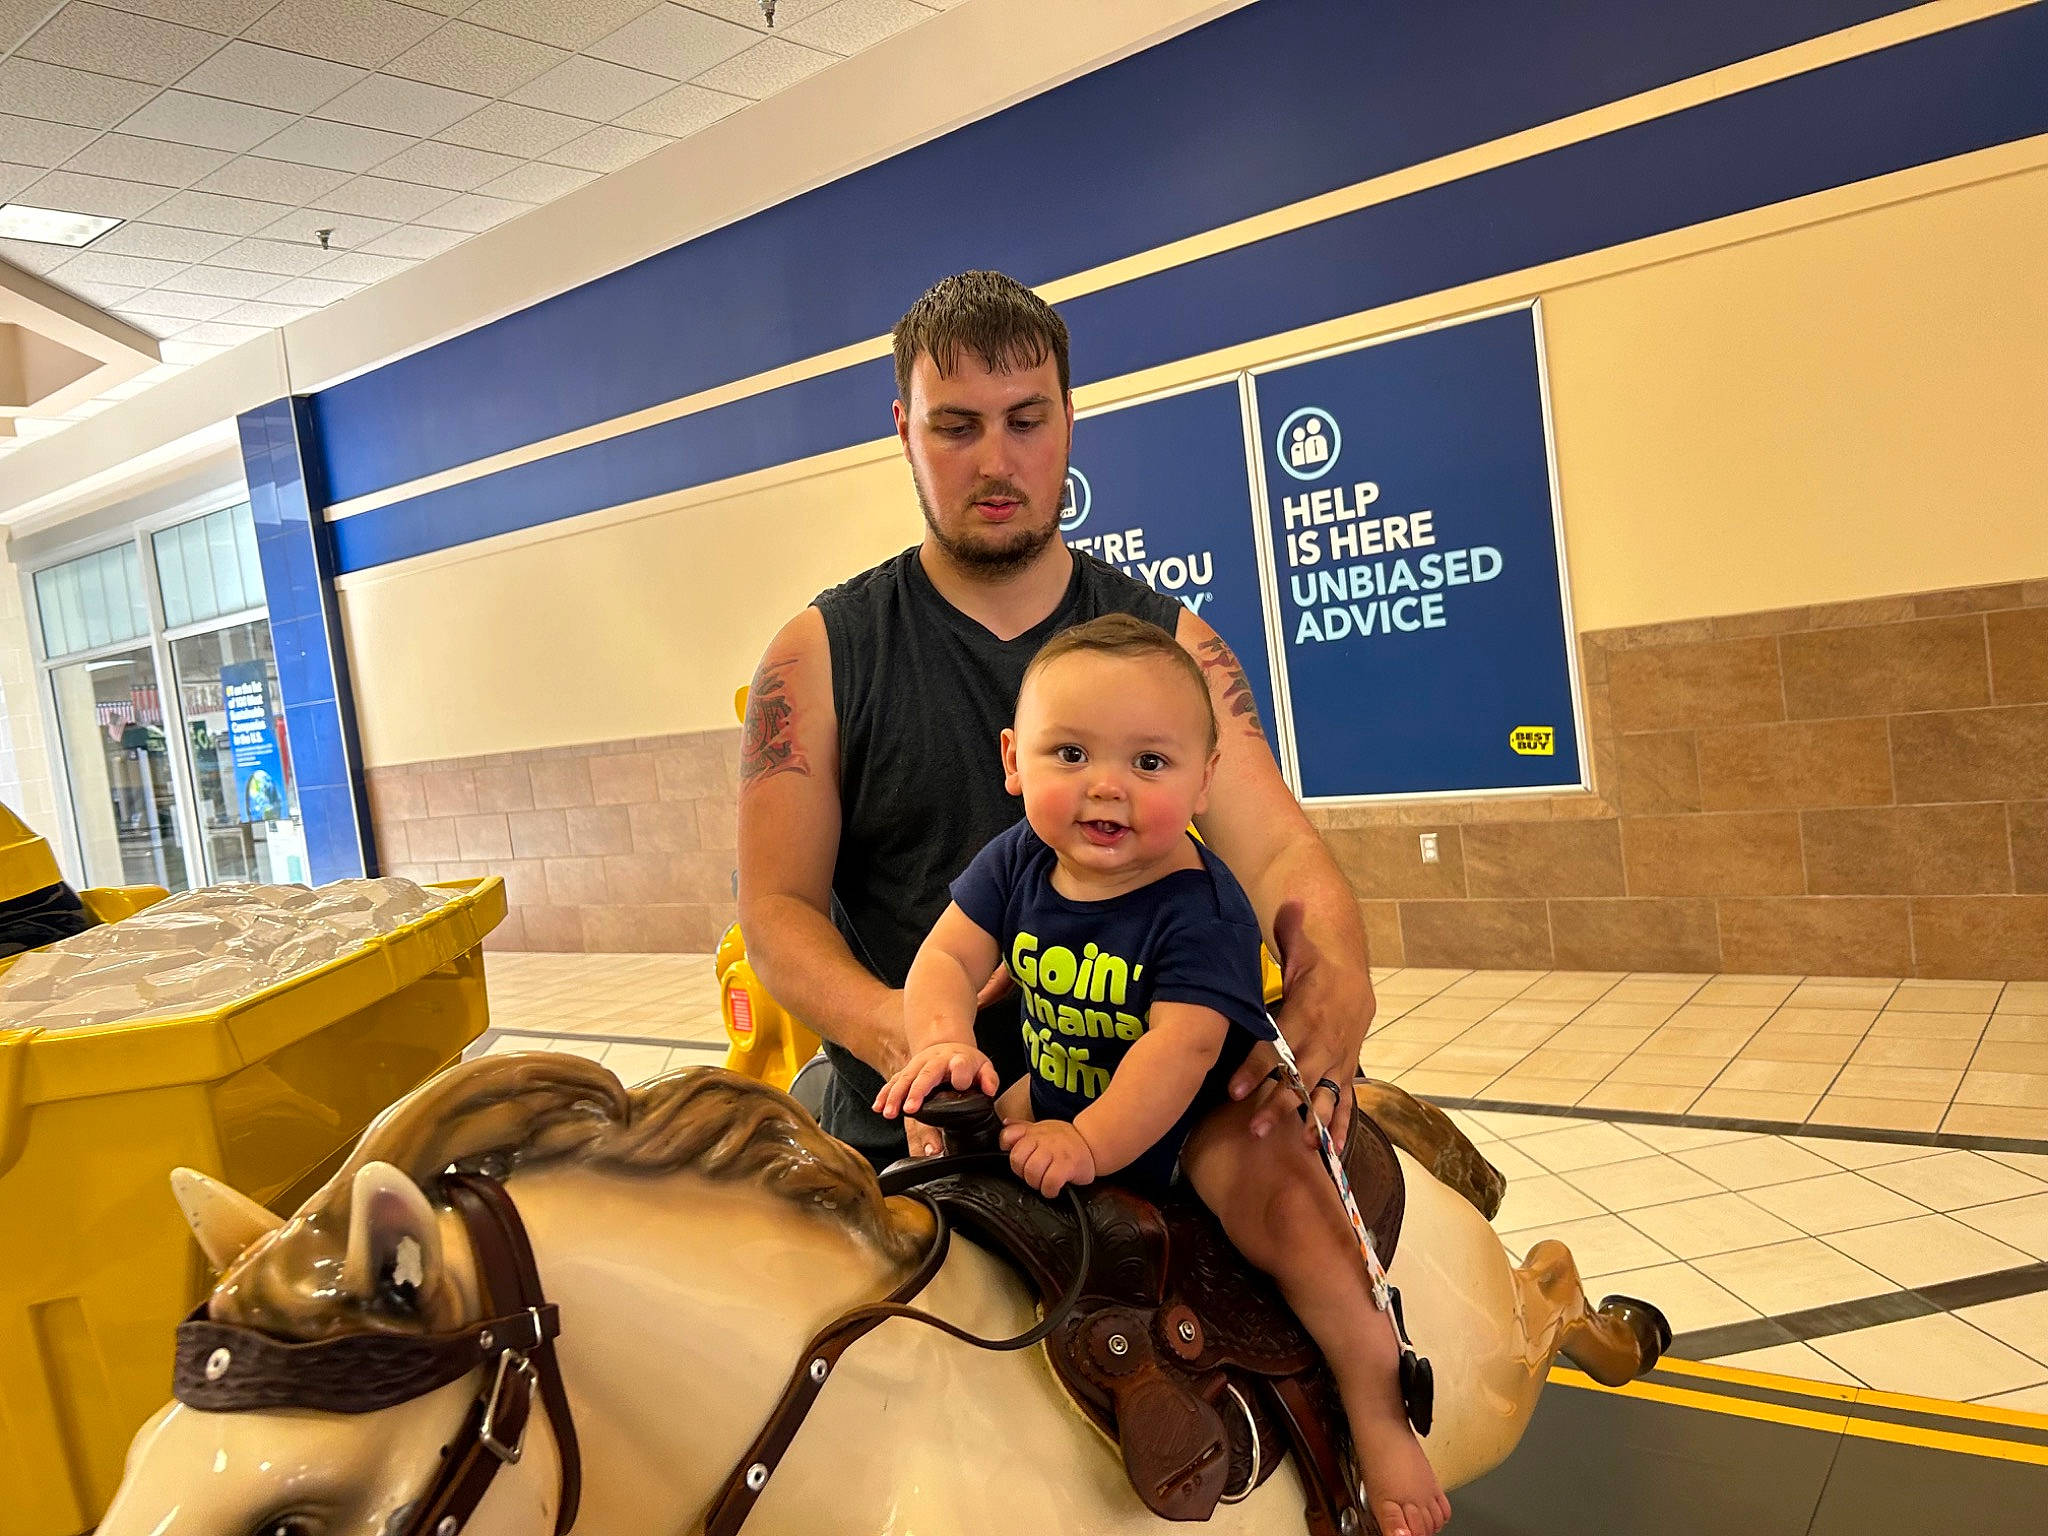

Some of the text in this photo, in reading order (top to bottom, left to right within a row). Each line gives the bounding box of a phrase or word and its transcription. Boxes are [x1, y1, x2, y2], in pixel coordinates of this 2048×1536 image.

[1283, 481, 1380, 530] HELP
[1286, 510, 1436, 567] IS HERE
[1137, 551, 1214, 592] YOU
[1290, 545, 1503, 607] UNBIASED
[1294, 593, 1447, 644] ADVICE
[1515, 732, 1551, 741] BEST
[1517, 741, 1548, 750] BUY
[1012, 931, 1143, 1005] Goin'
